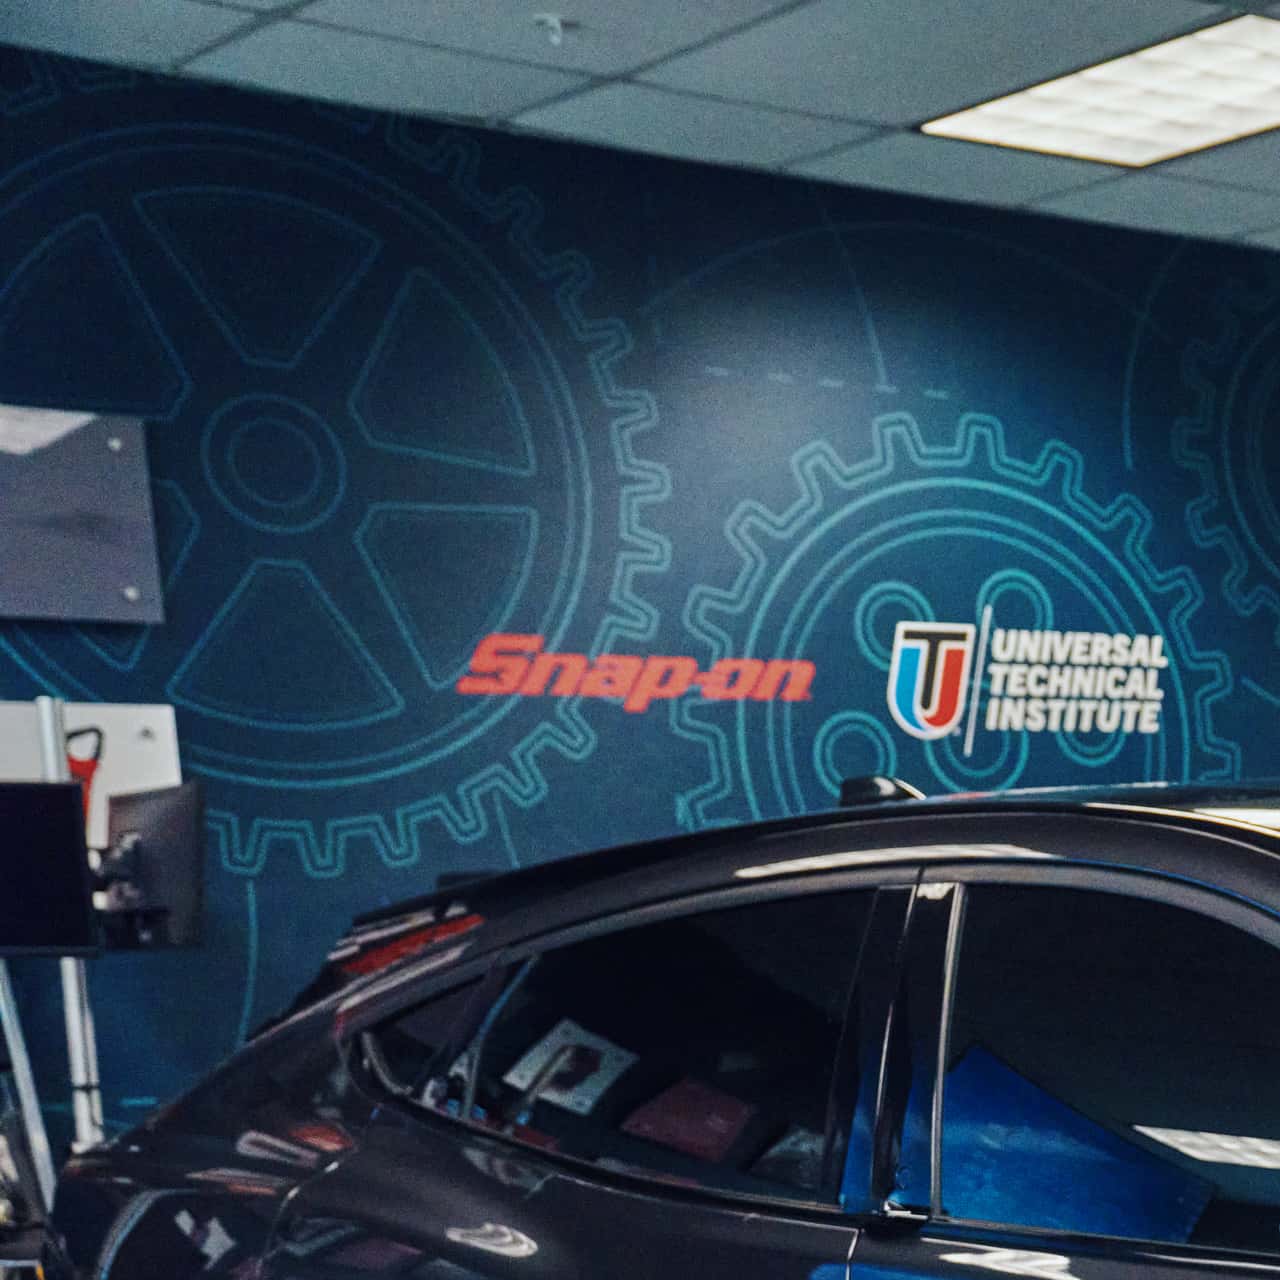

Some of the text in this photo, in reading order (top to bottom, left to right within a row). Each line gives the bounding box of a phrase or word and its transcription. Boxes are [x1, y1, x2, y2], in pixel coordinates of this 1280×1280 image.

[991, 628, 1168, 668] UNIVERSAL
[456, 632, 816, 713] Snap-on
[987, 663, 1165, 700] TECHNICAL
[984, 698, 1161, 733] INSTITUTE
